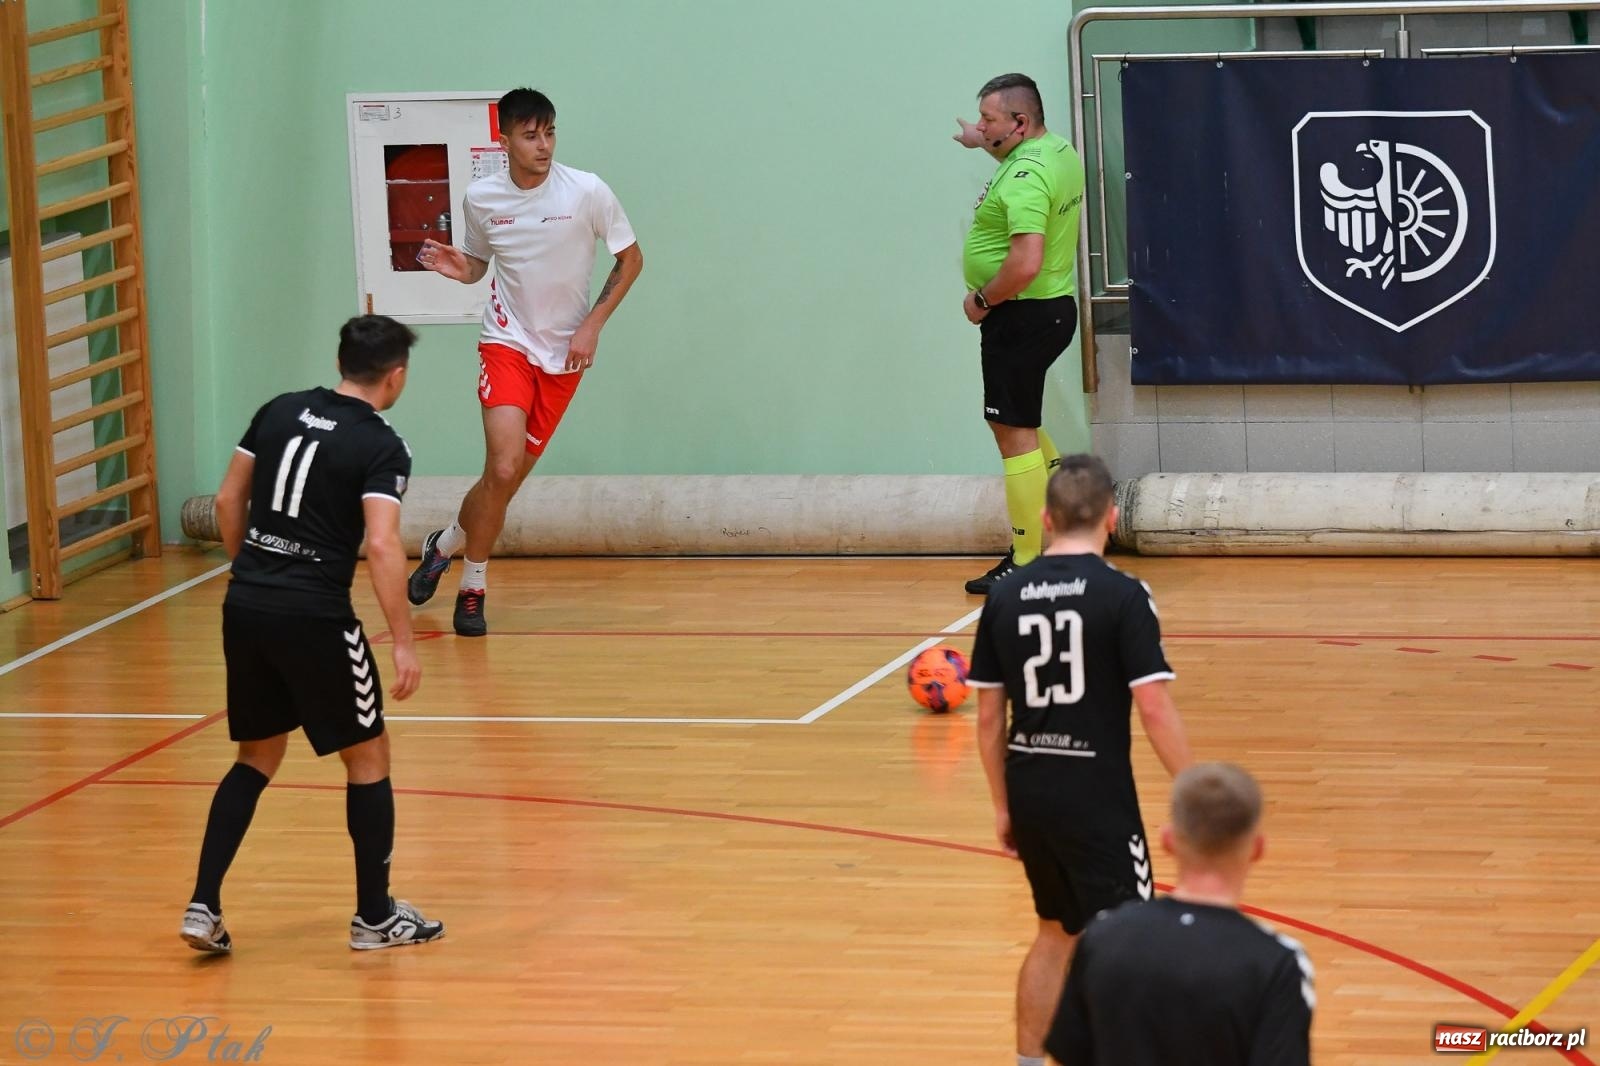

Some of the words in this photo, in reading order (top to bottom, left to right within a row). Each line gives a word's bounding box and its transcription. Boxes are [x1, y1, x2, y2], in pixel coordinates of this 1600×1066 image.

[490, 217, 515, 226] hummel
[271, 435, 320, 519] 11
[1018, 609, 1086, 708] 23
